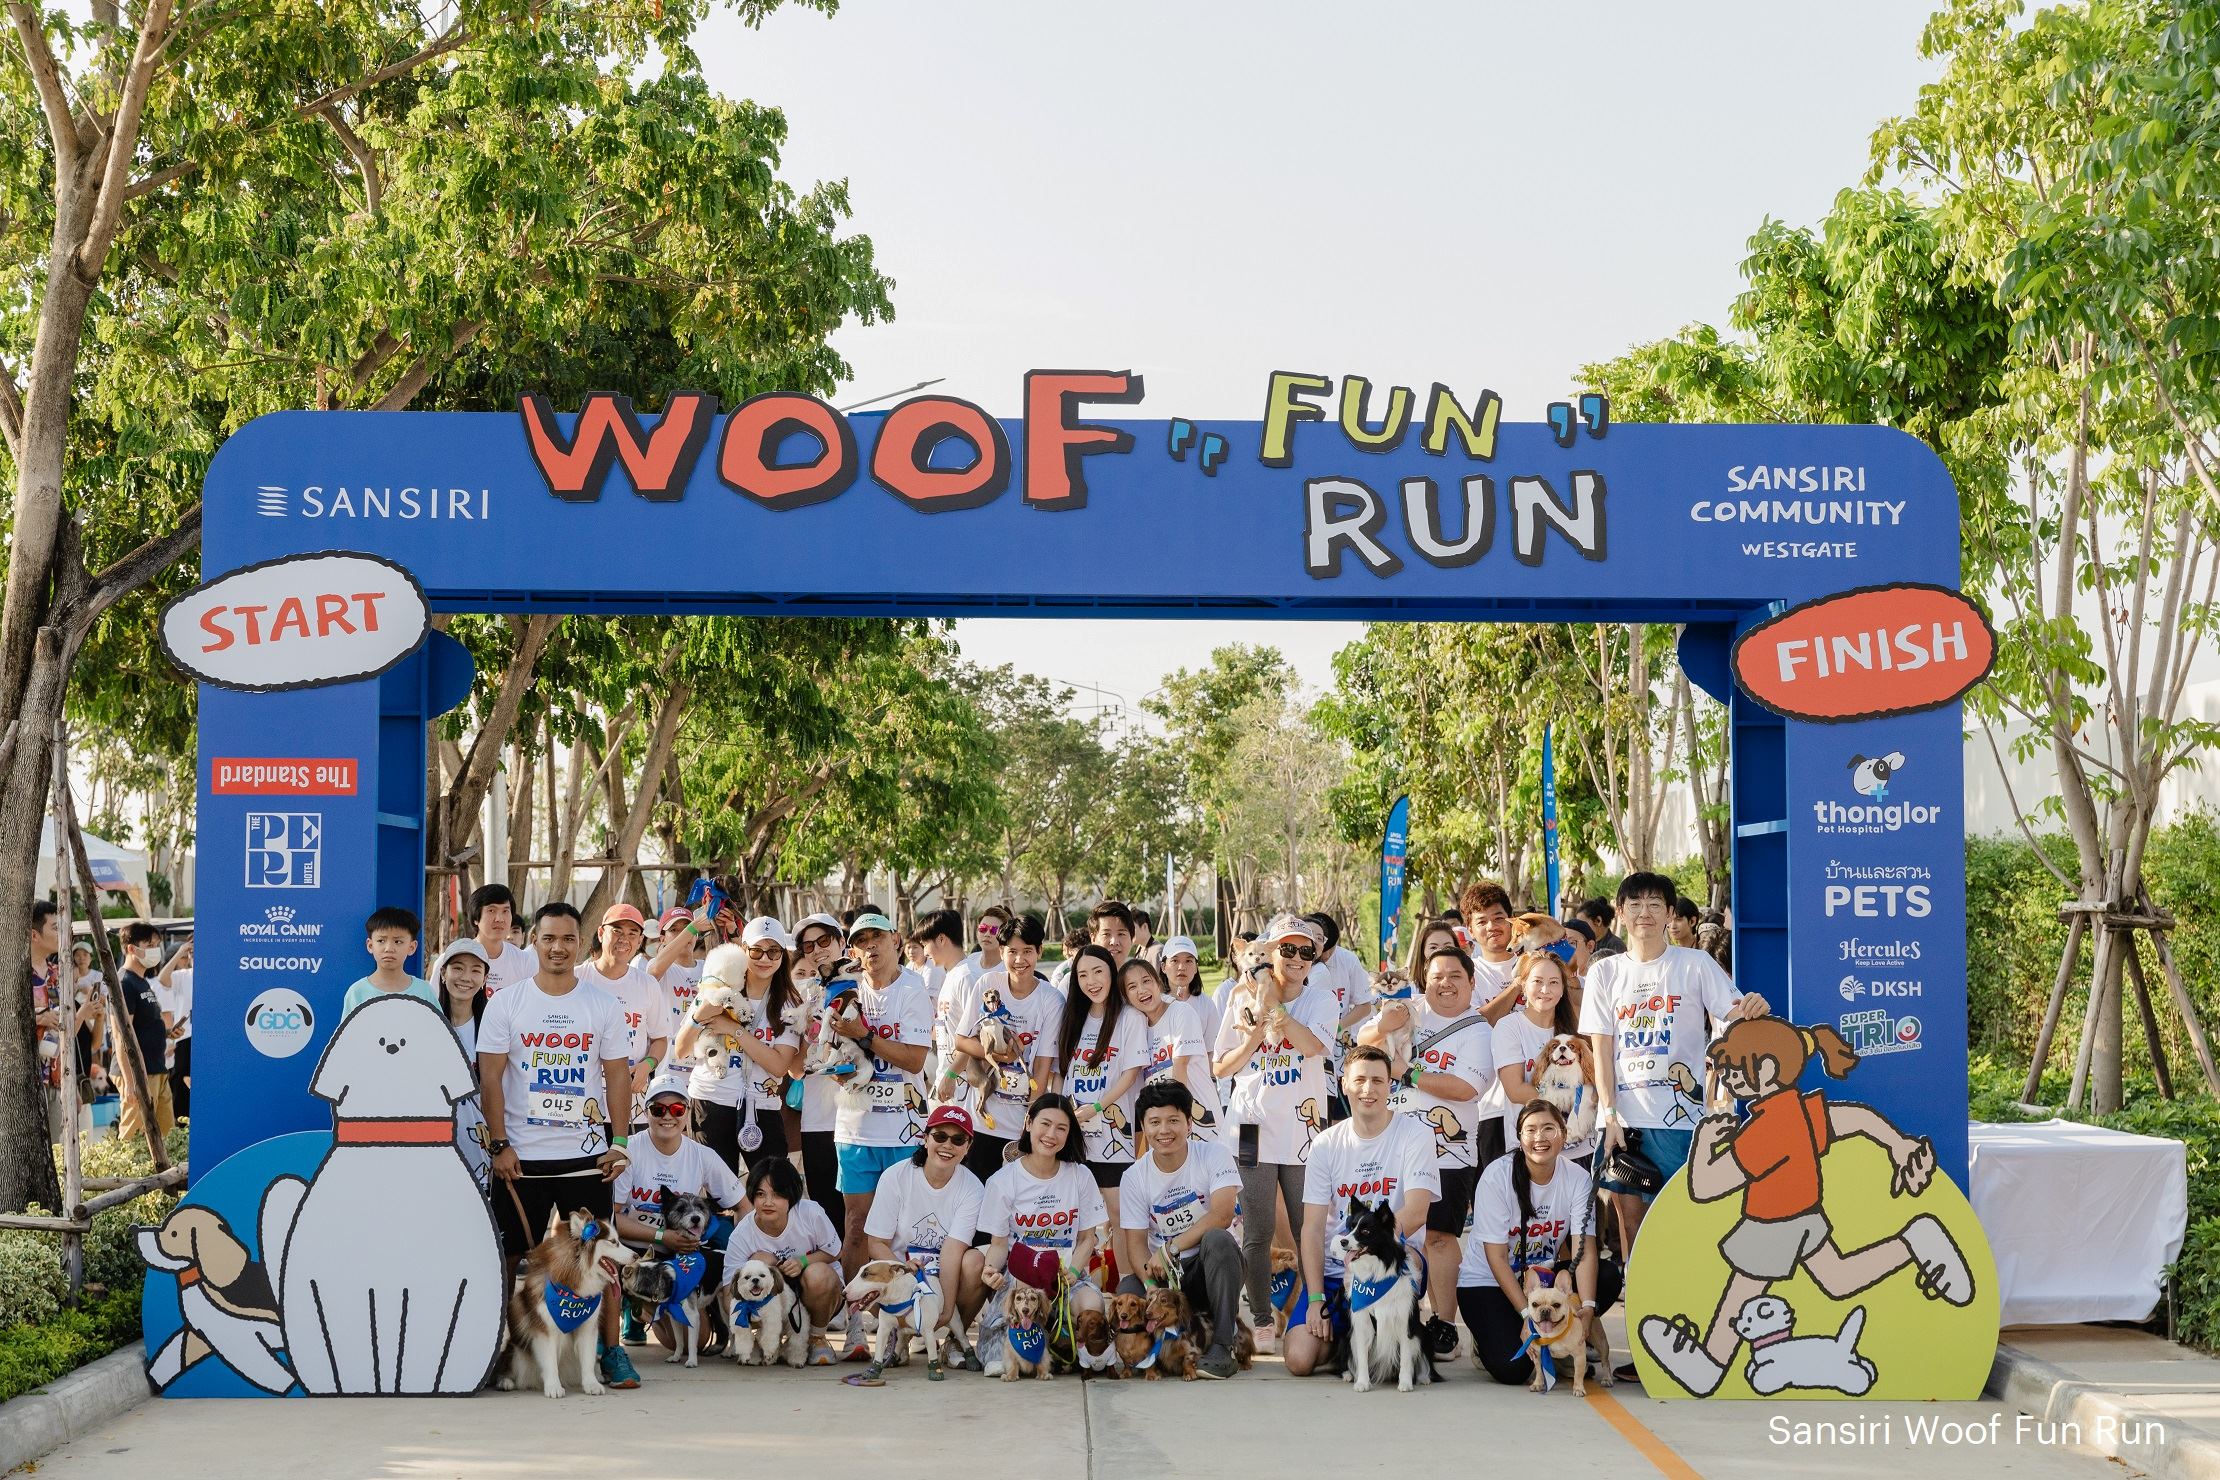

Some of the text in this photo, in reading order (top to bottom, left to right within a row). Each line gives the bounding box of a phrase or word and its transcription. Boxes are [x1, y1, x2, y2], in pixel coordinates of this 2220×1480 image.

[1258, 370, 1500, 468] FUN
[517, 369, 1144, 513] WOOF
[1728, 465, 1865, 493] SANSIRI
[302, 486, 488, 520] SANSIRI
[1690, 500, 1905, 526] COMMUNITY
[1303, 470, 1607, 580] RUN
[1742, 542, 1858, 559] WESTGATE
[199, 592, 386, 654] START
[1776, 621, 1968, 683] FINISH
[220, 765, 350, 788] The Standard
[251, 816, 260, 830] THE
[1813, 801, 1940, 831] thonglor
[1817, 825, 1884, 835] Pet Hospital
[303, 861, 313, 884] HOTEL
[1825, 859, 1931, 879] บ้านและสวน
[1825, 885, 1932, 918] PETS
[240, 924, 278, 935] ROYAL
[239, 956, 323, 974] saucony
[1871, 981, 1921, 997] DKSH
[258, 1012, 301, 1030] GDC
[1630, 1015, 1655, 1029] UN
[1841, 1010, 1886, 1026] SUPER
[1624, 1030, 1671, 1048] RUN
[1841, 1016, 1922, 1048] TRIO
[520, 1032, 594, 1052] WOOF
[532, 1051, 571, 1068] FUN
[1628, 1060, 1655, 1072] 090
[538, 1067, 585, 1084] RUN
[1006, 1076, 1018, 1089] 23
[867, 1085, 894, 1098] 030
[1075, 1076, 1107, 1094] RUN
[542, 1098, 574, 1112] 045
[1337, 1177, 1397, 1197] WOOF
[638, 1214, 664, 1228] 074
[1015, 1208, 1079, 1228] WOOF
[1166, 1209, 1193, 1226] 043
[1271, 1279, 1289, 1295] UN
[1352, 1279, 1376, 1297] RUN
[559, 1298, 585, 1309] FUN
[560, 1306, 592, 1318] RUN
[1016, 1326, 1038, 1341] FUN
[1022, 1329, 1043, 1350] RUN
